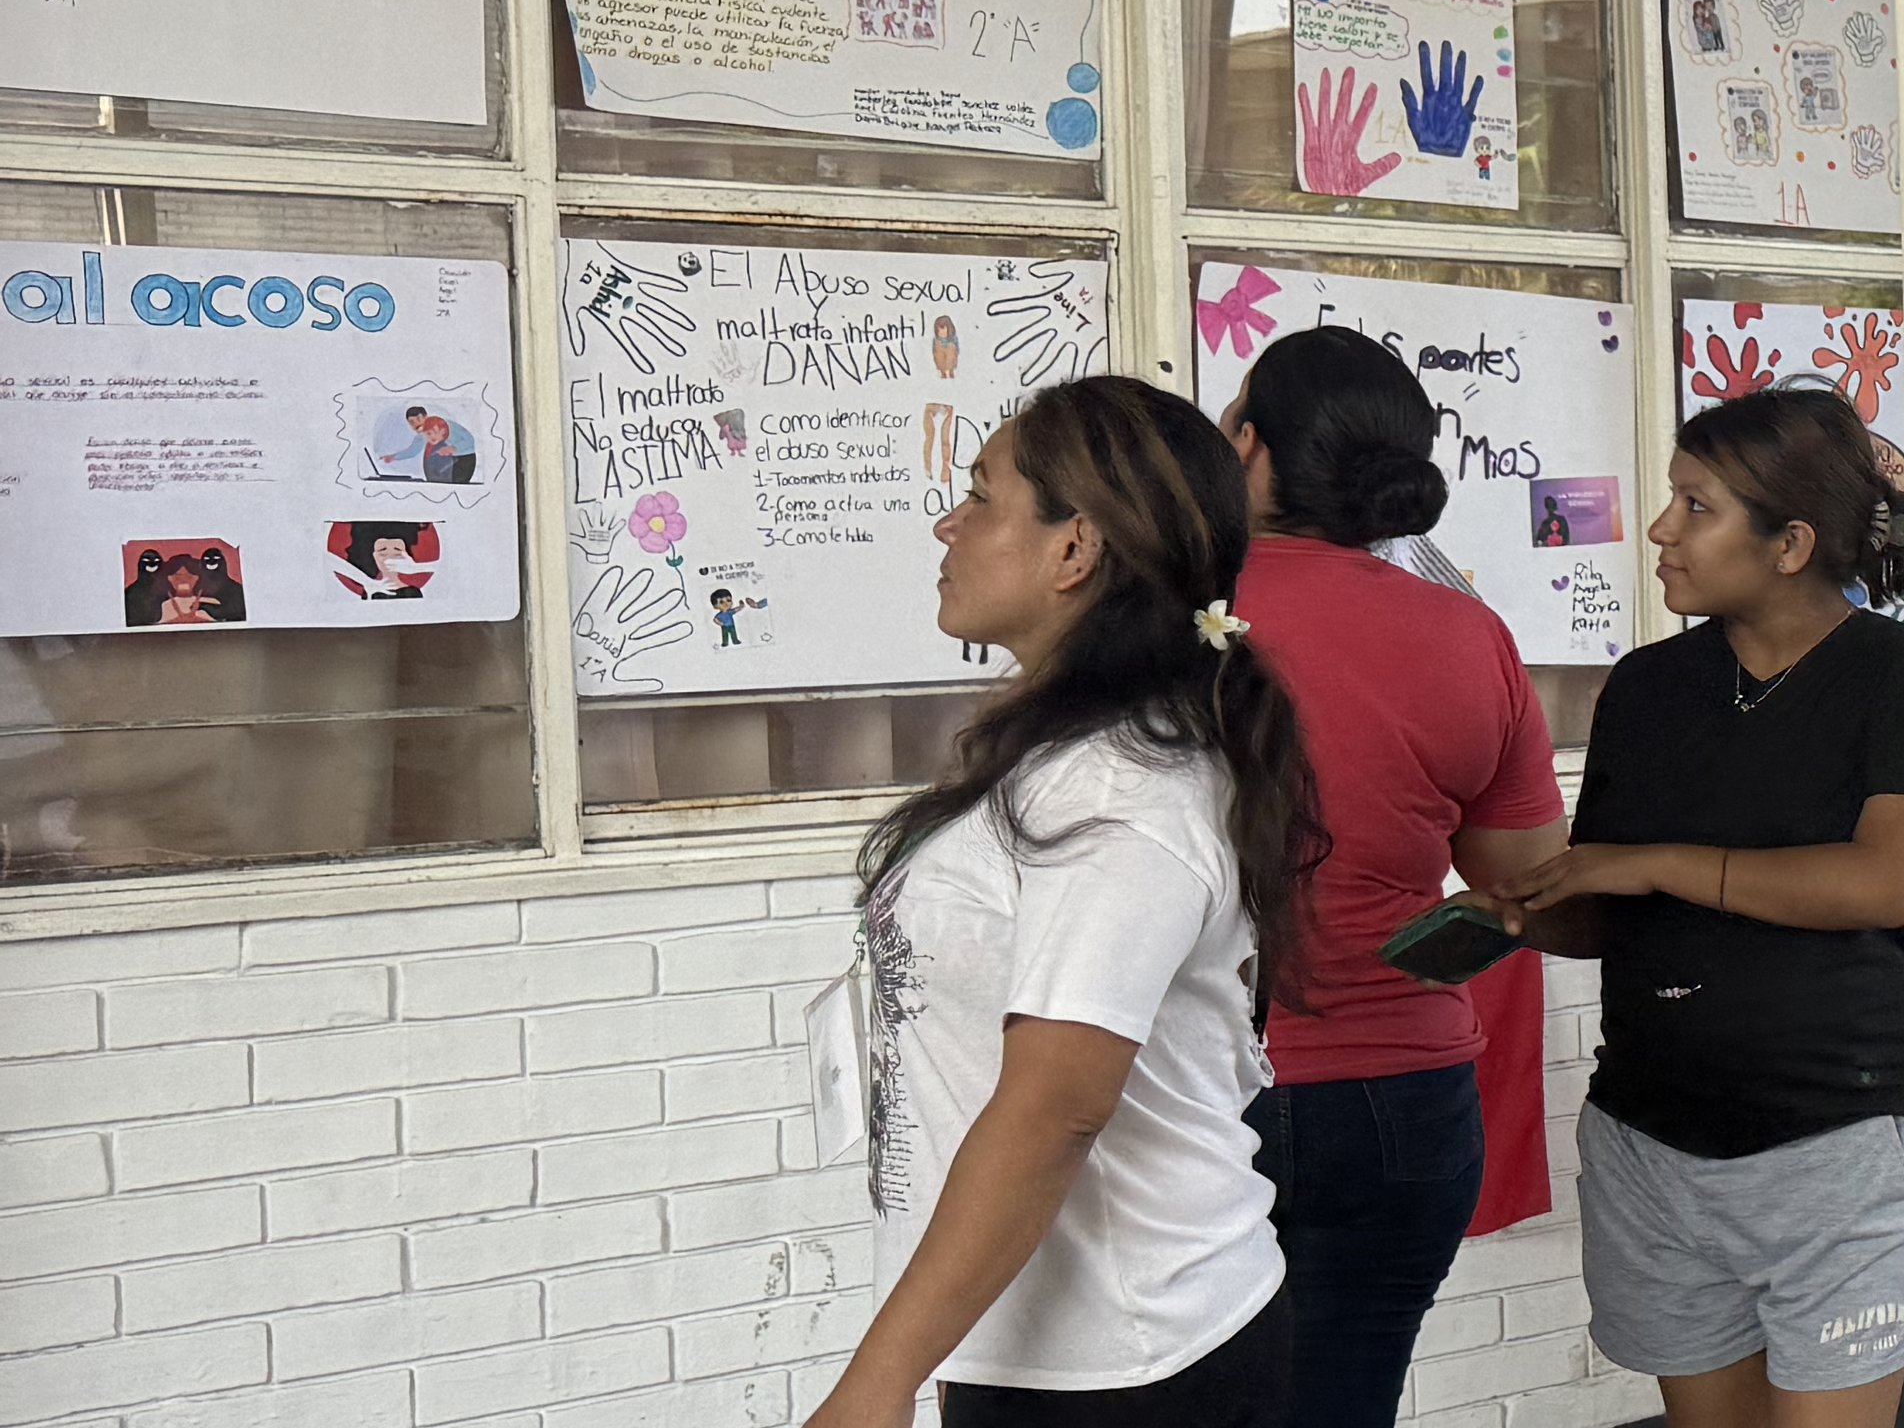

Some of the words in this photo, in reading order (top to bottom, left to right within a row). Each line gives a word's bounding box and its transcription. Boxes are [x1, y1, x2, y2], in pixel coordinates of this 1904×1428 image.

[2, 251, 104, 325] al
[131, 273, 396, 333] acoso
[710, 249, 752, 289] El
[775, 252, 870, 296] Abuso
[884, 269, 971, 303] sexual
[717, 306, 832, 341] maltrato
[842, 310, 925, 345] infantil
[570, 372, 605, 420] El
[617, 374, 724, 415] maltrato
[574, 421, 612, 453] No
[755, 438, 771, 462] el
[777, 437, 829, 461] abuso
[574, 429, 723, 504] LASTIMA
[884, 499, 910, 511] una
